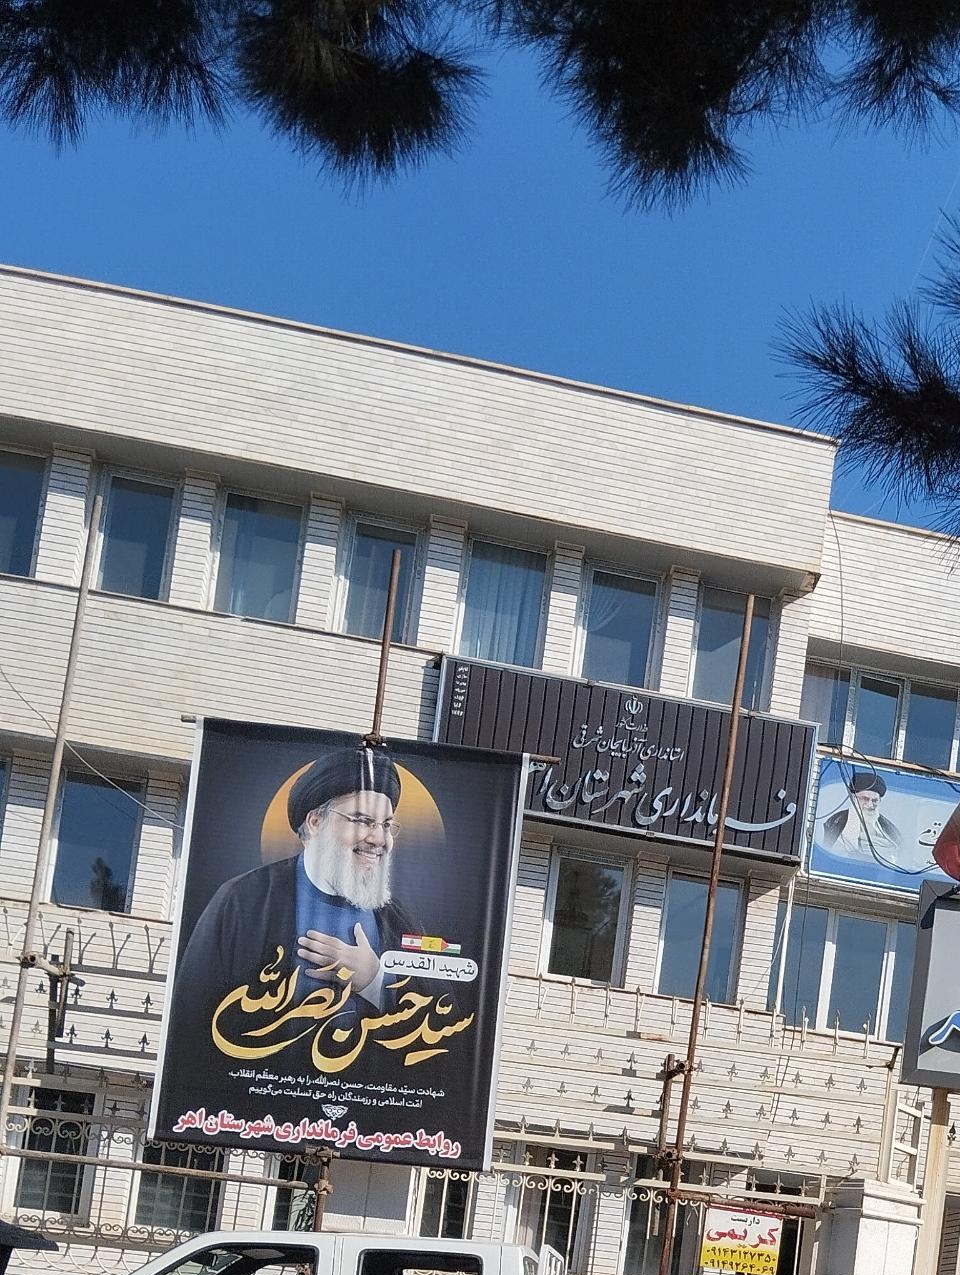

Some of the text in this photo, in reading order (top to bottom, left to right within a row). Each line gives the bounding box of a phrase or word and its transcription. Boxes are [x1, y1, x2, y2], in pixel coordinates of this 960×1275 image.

[625, 722, 648, 733] وزارت
[572, 724, 685, 761] استانداری آذربایجان شرقی
[528, 761, 553, 793] اه
[546, 763, 647, 815] شهرستان
[384, 957, 475, 979] شهید القدس
[279, 1074, 296, 1085] رهبر
[297, 1076, 305, 1084] به
[340, 1080, 363, 1090] حسن
[283, 1087, 313, 1098] تسلیت
[312, 1089, 326, 1099] حق
[327, 1090, 337, 1101] راه
[337, 1091, 371, 1104] رزمندگان
[417, 1087, 445, 1098] شهادت
[377, 1096, 405, 1107] اسلامی
[173, 1108, 461, 1158] روابط عمومی فرمانداری شهرستان اهر
[730, 1214, 760, 1226] داربست
[706, 1227, 779, 1249] کریمی
